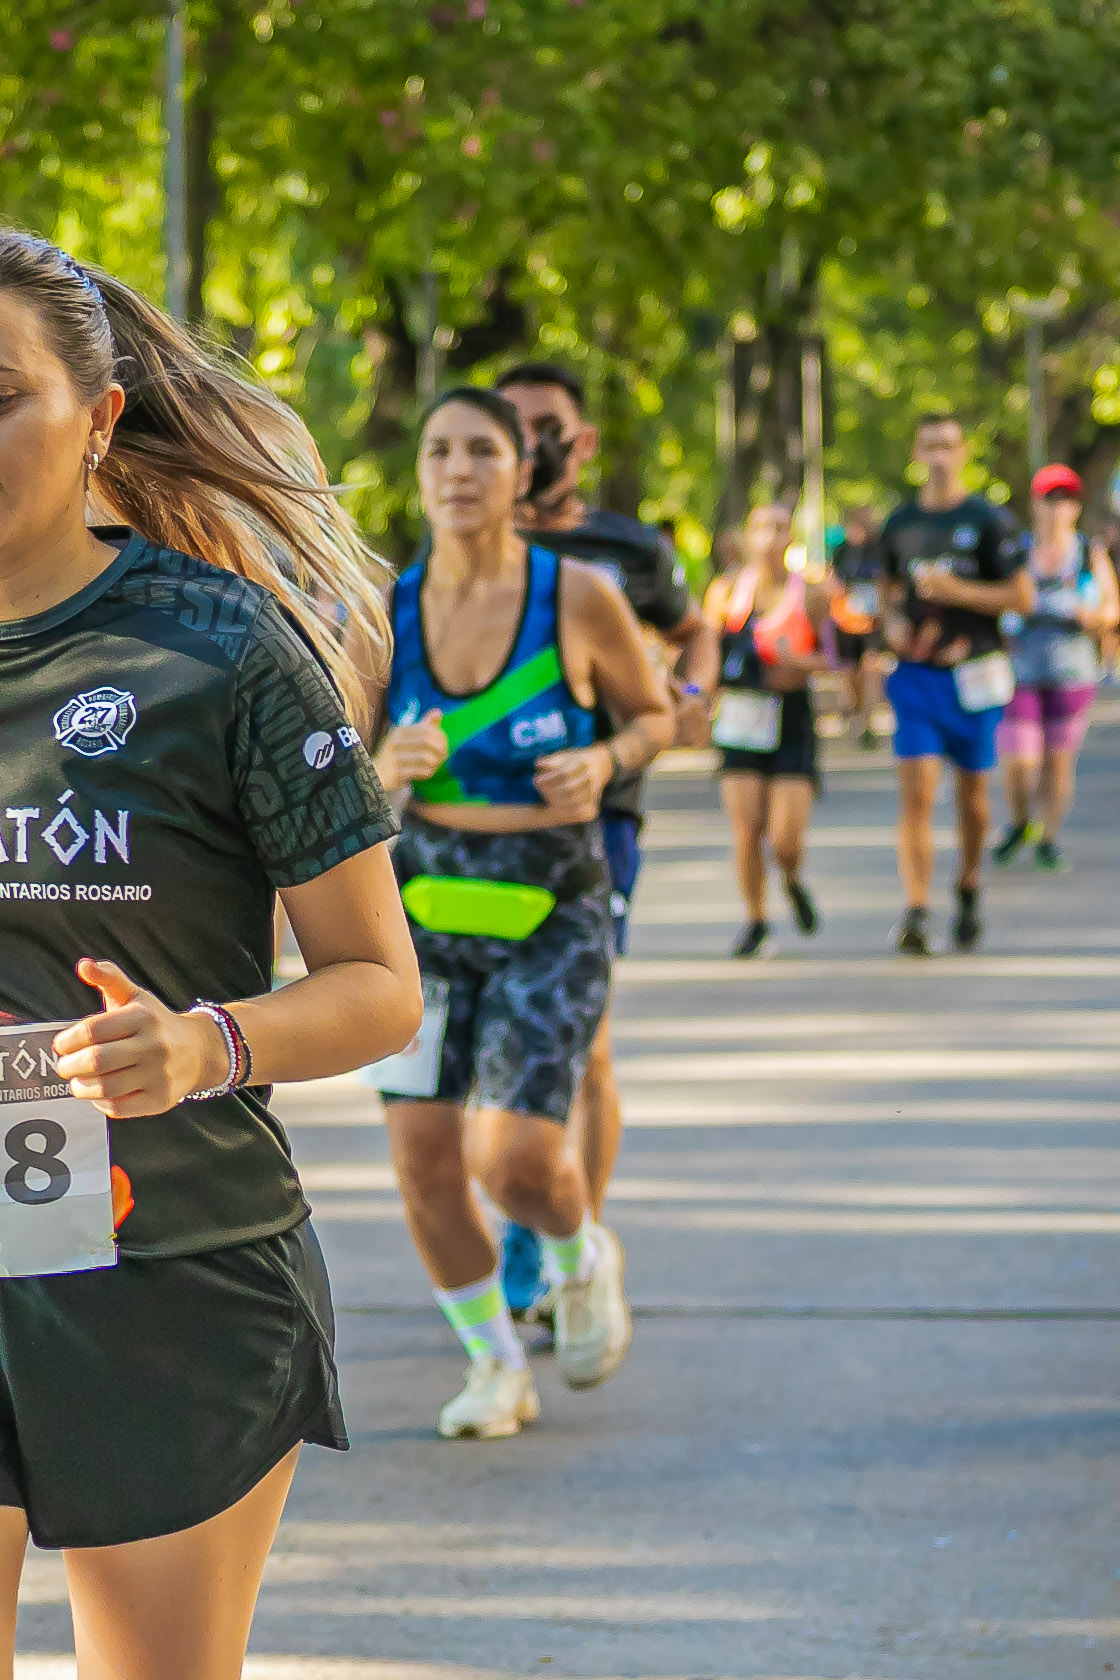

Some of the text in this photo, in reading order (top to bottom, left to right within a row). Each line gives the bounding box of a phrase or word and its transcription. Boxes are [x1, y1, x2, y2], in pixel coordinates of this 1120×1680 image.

[78, 706, 113, 725] 27
[76, 885, 152, 901] ROSARIO
[43, 1082, 72, 1097] ROSA
